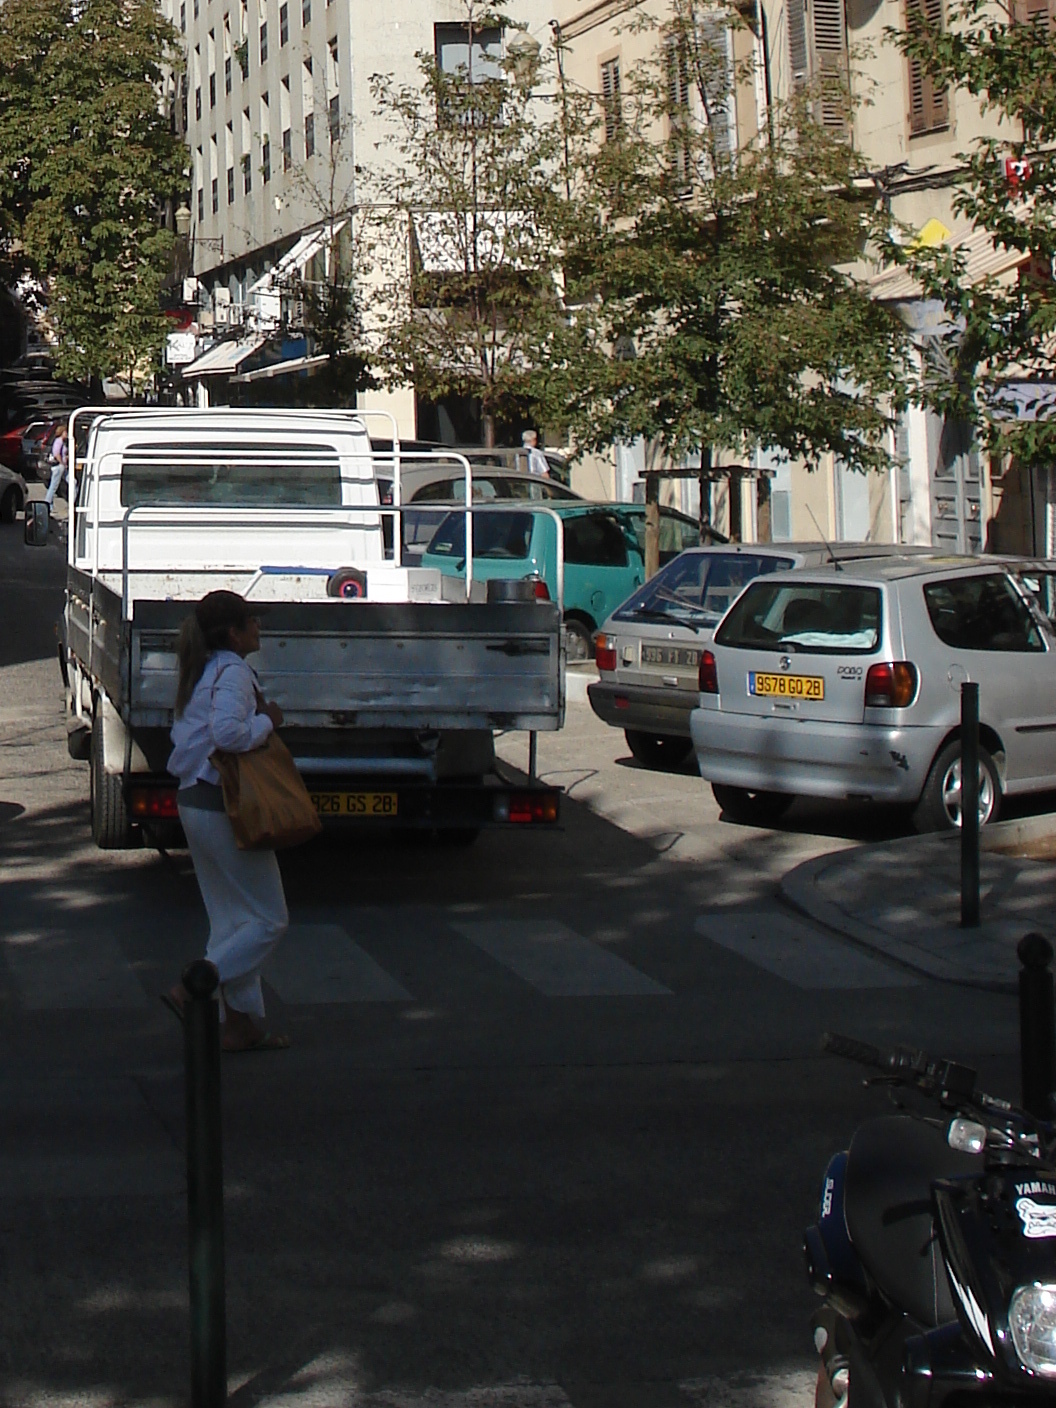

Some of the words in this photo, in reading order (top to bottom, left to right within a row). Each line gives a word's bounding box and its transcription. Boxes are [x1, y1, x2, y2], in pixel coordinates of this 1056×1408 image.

[806, 680, 821, 696] 2B
[347, 795, 366, 812] GS
[372, 795, 392, 813] 2B
